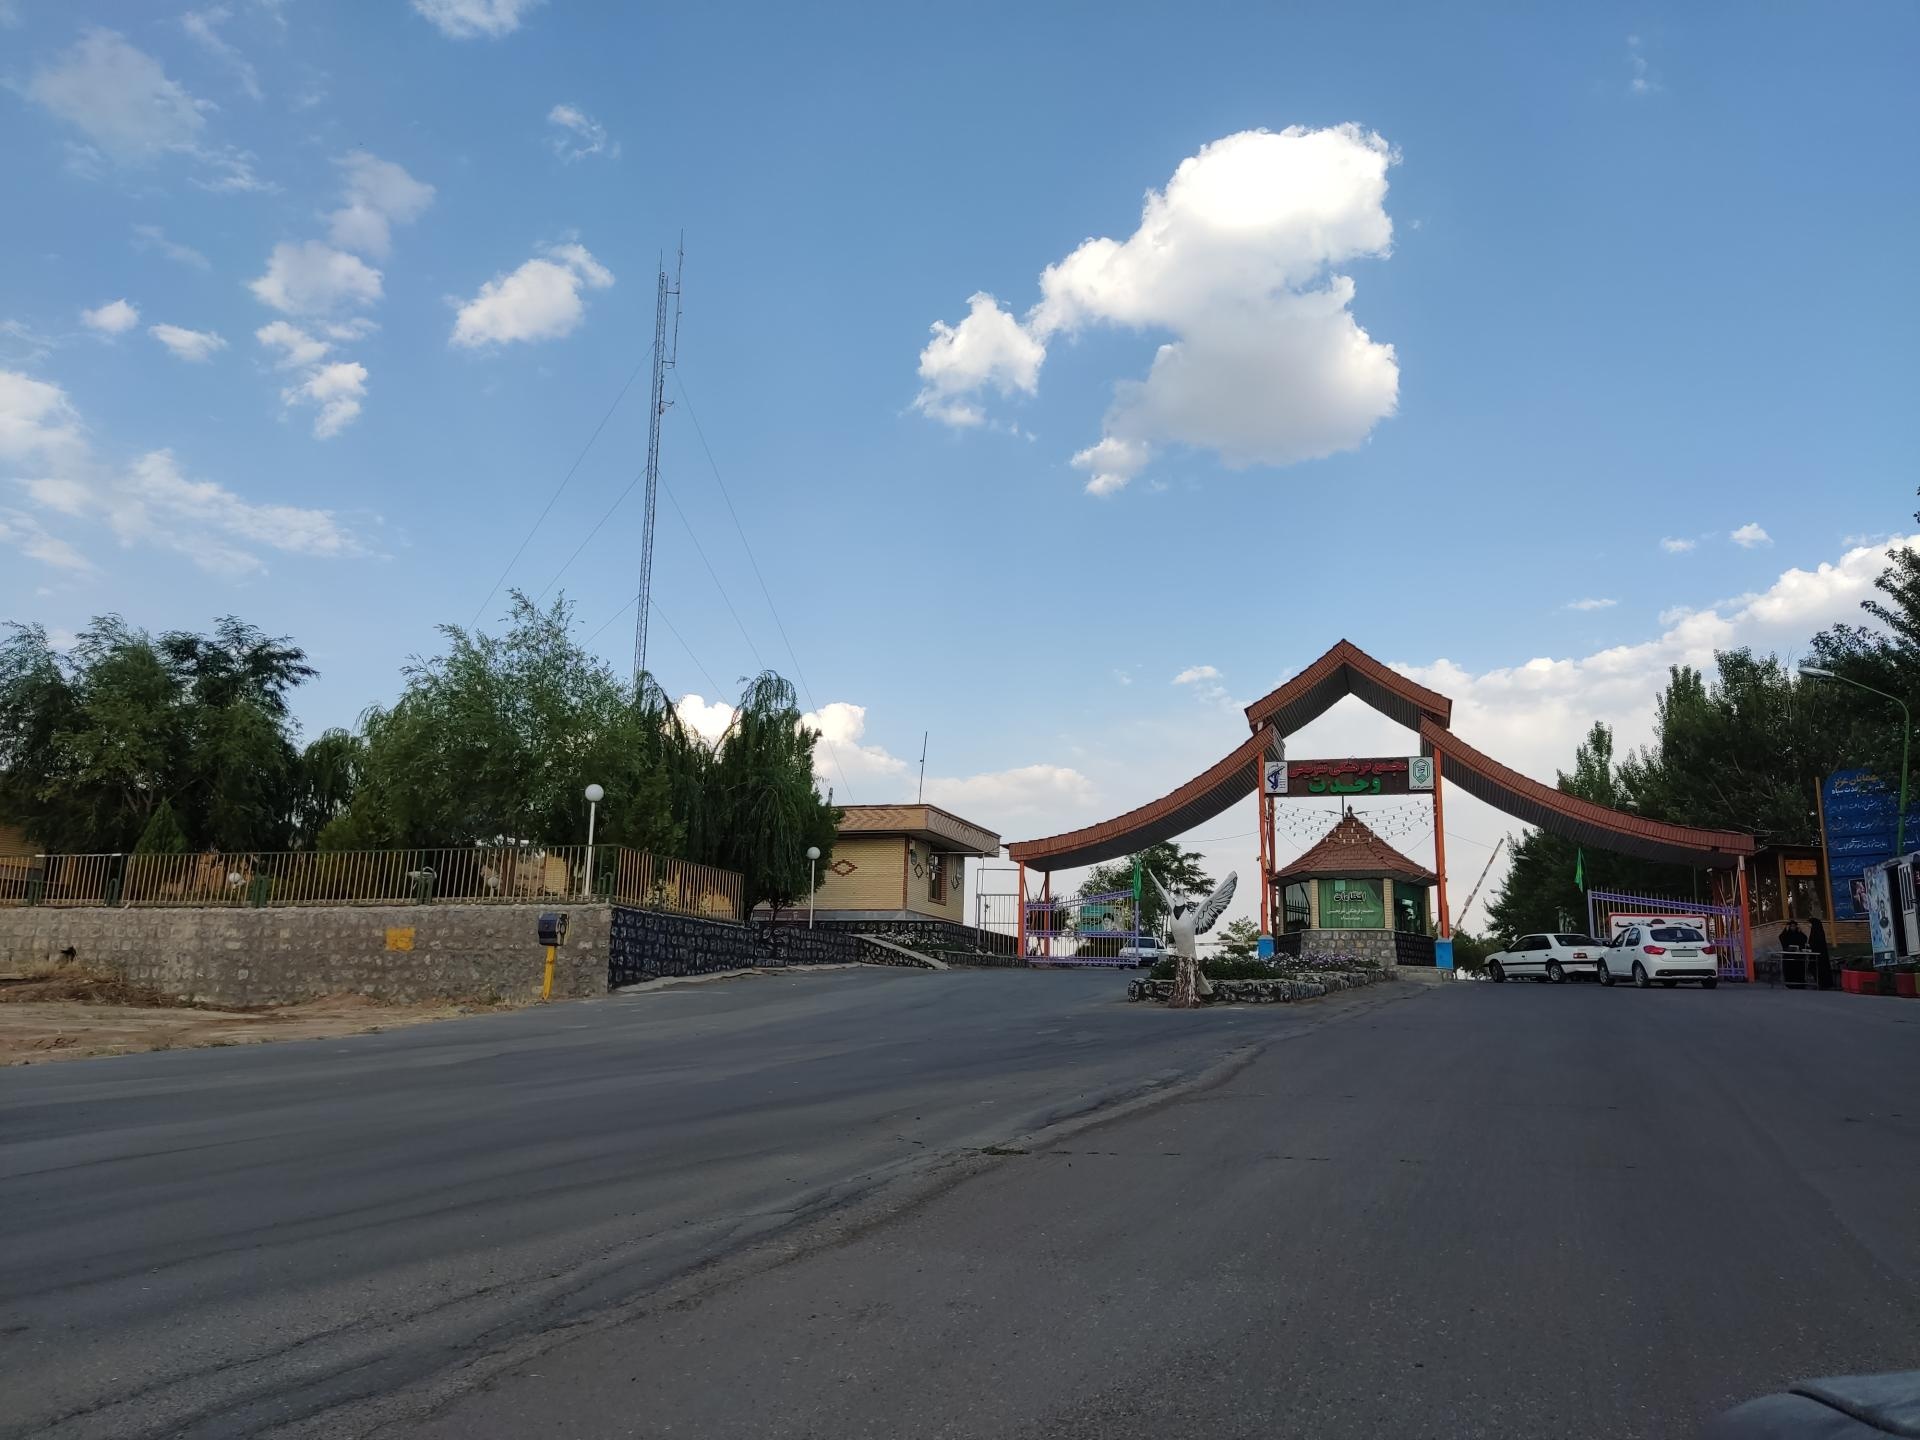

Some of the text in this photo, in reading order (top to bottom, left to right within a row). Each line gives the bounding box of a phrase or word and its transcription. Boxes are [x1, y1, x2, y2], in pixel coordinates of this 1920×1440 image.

[1288, 758, 1408, 778] مجتمع فرهنگی تفریحی
[1308, 777, 1382, 794] وحدت
[1334, 891, 1367, 904] انتظامات
